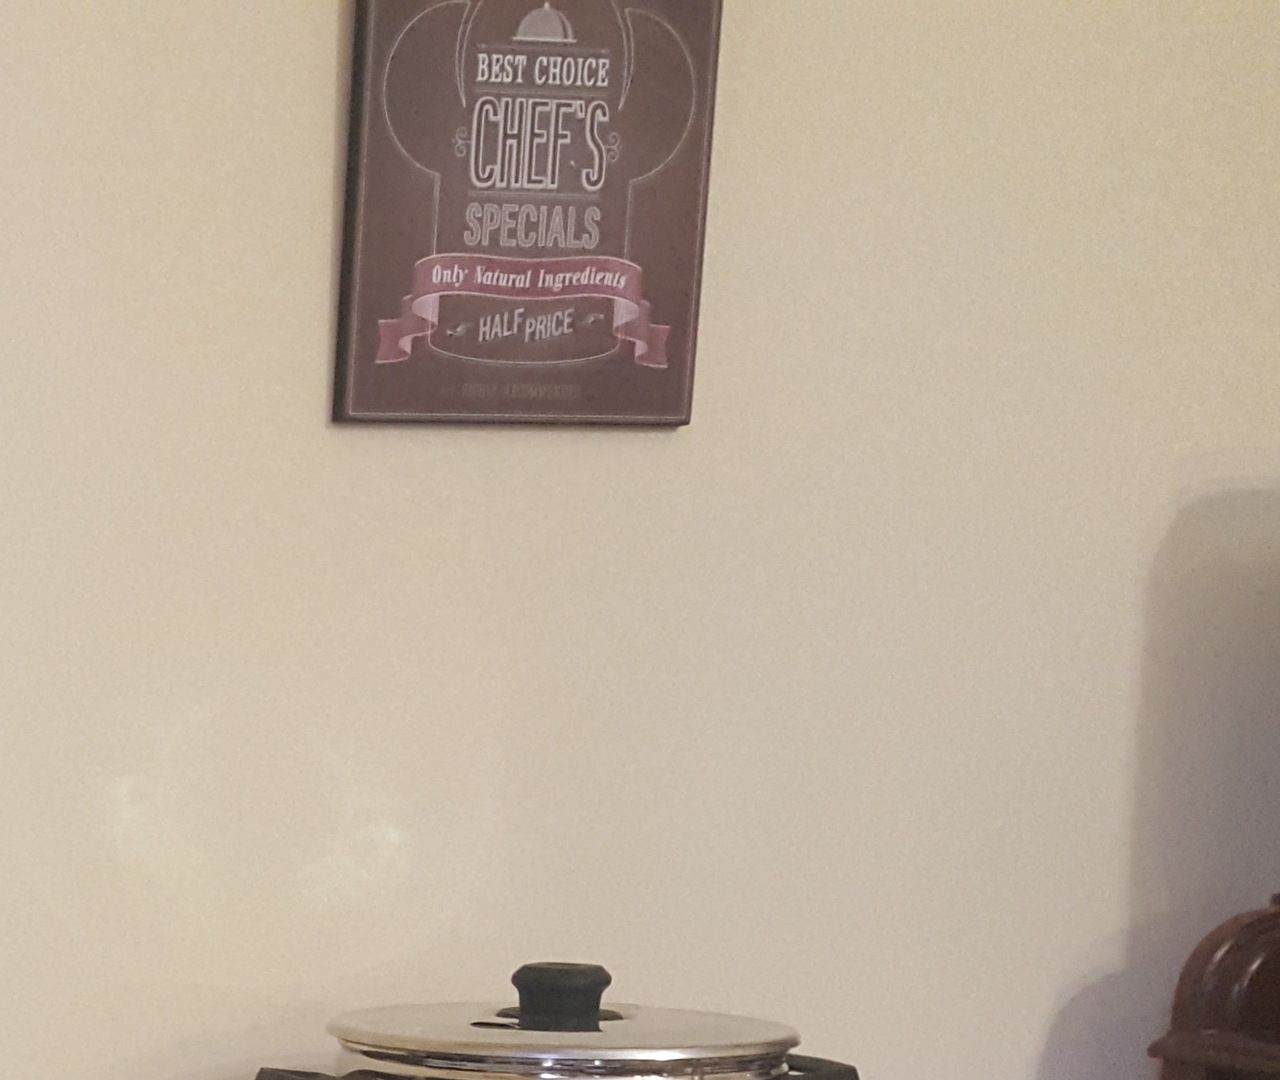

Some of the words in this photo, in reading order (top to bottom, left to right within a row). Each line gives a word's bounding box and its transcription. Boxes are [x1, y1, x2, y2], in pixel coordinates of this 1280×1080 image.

[476, 53, 528, 83] BEST
[534, 56, 611, 87] CHOICE
[470, 96, 609, 191] CHEF'S
[463, 202, 601, 249] SPECIALS
[431, 264, 468, 287] Only
[474, 265, 531, 288] Natural
[537, 267, 627, 291] Ingredients
[478, 307, 525, 342] HALF
[524, 308, 575, 343] PRICE
